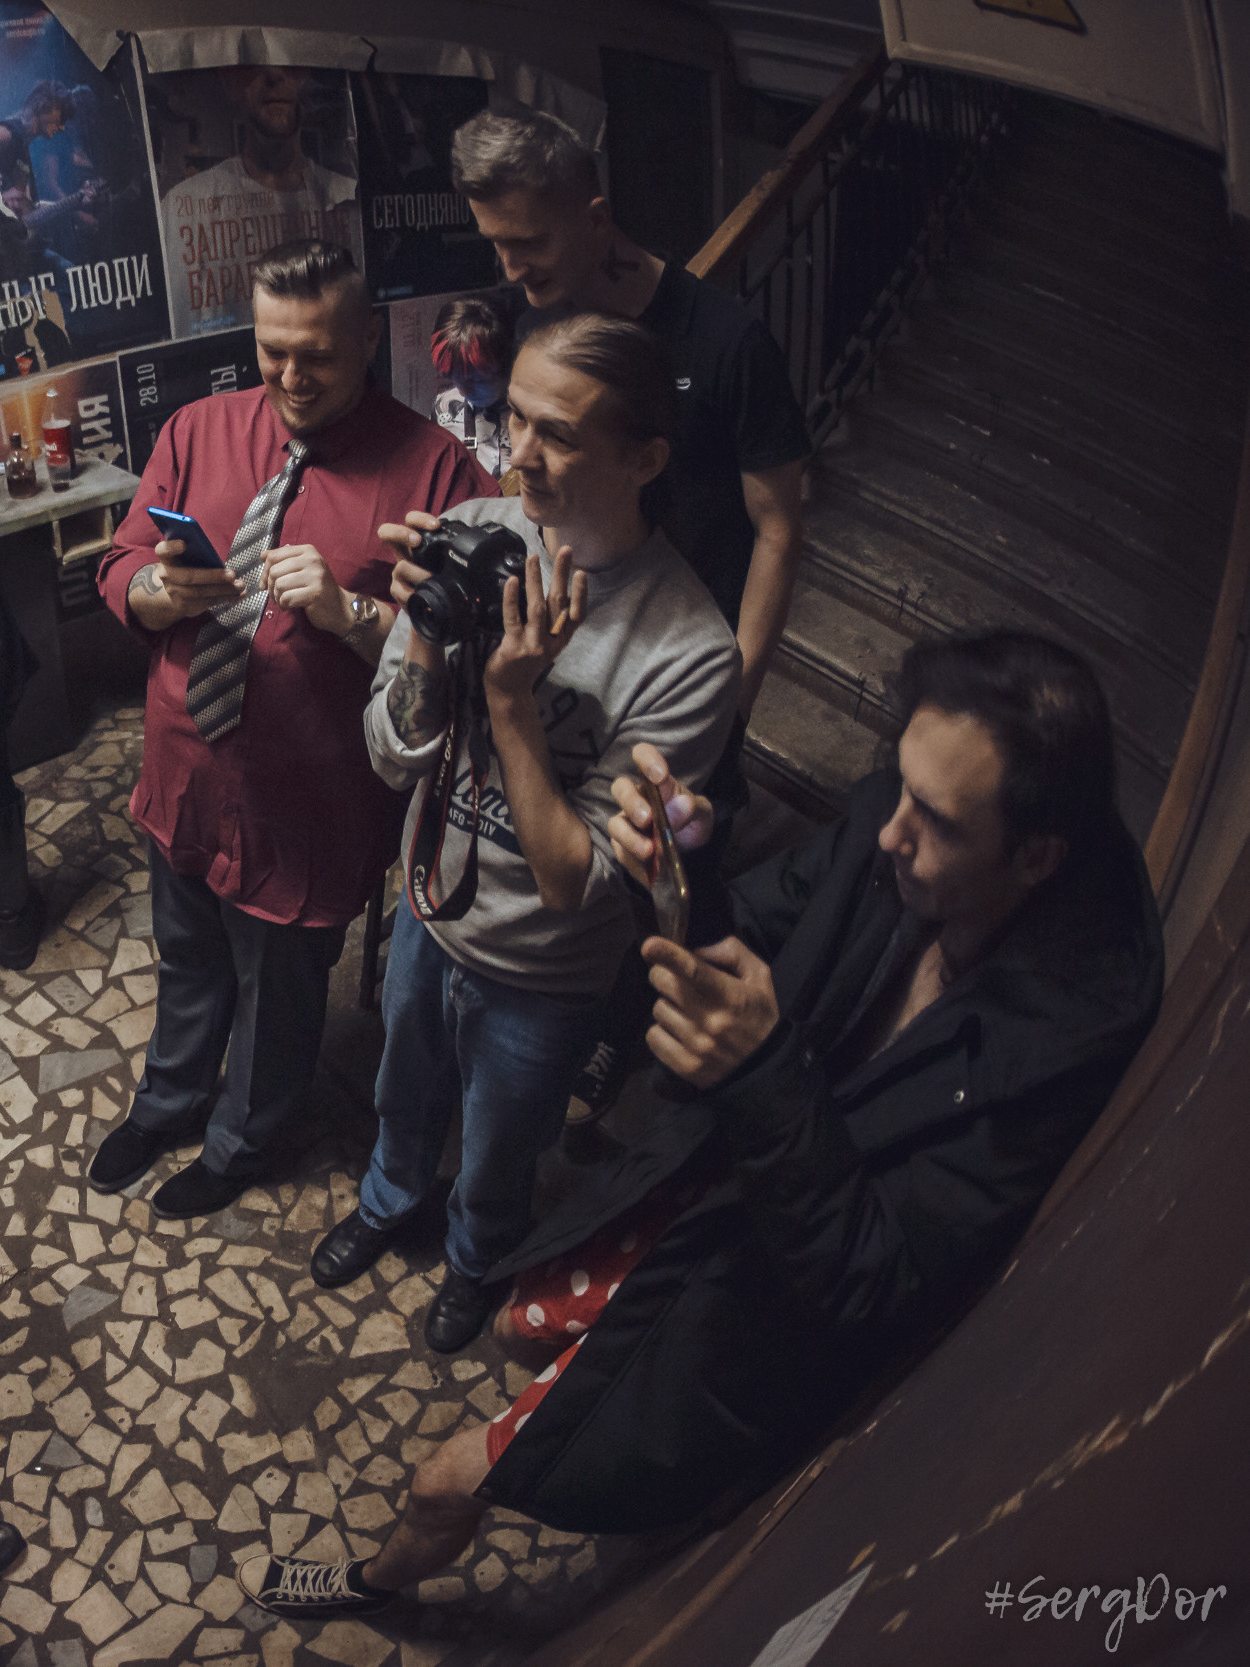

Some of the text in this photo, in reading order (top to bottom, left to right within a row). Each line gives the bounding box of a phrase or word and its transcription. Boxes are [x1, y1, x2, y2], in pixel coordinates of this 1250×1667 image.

[175, 194, 194, 218] 20
[66, 253, 153, 313] ЛЮДИ
[136, 363, 158, 408] 28.10
